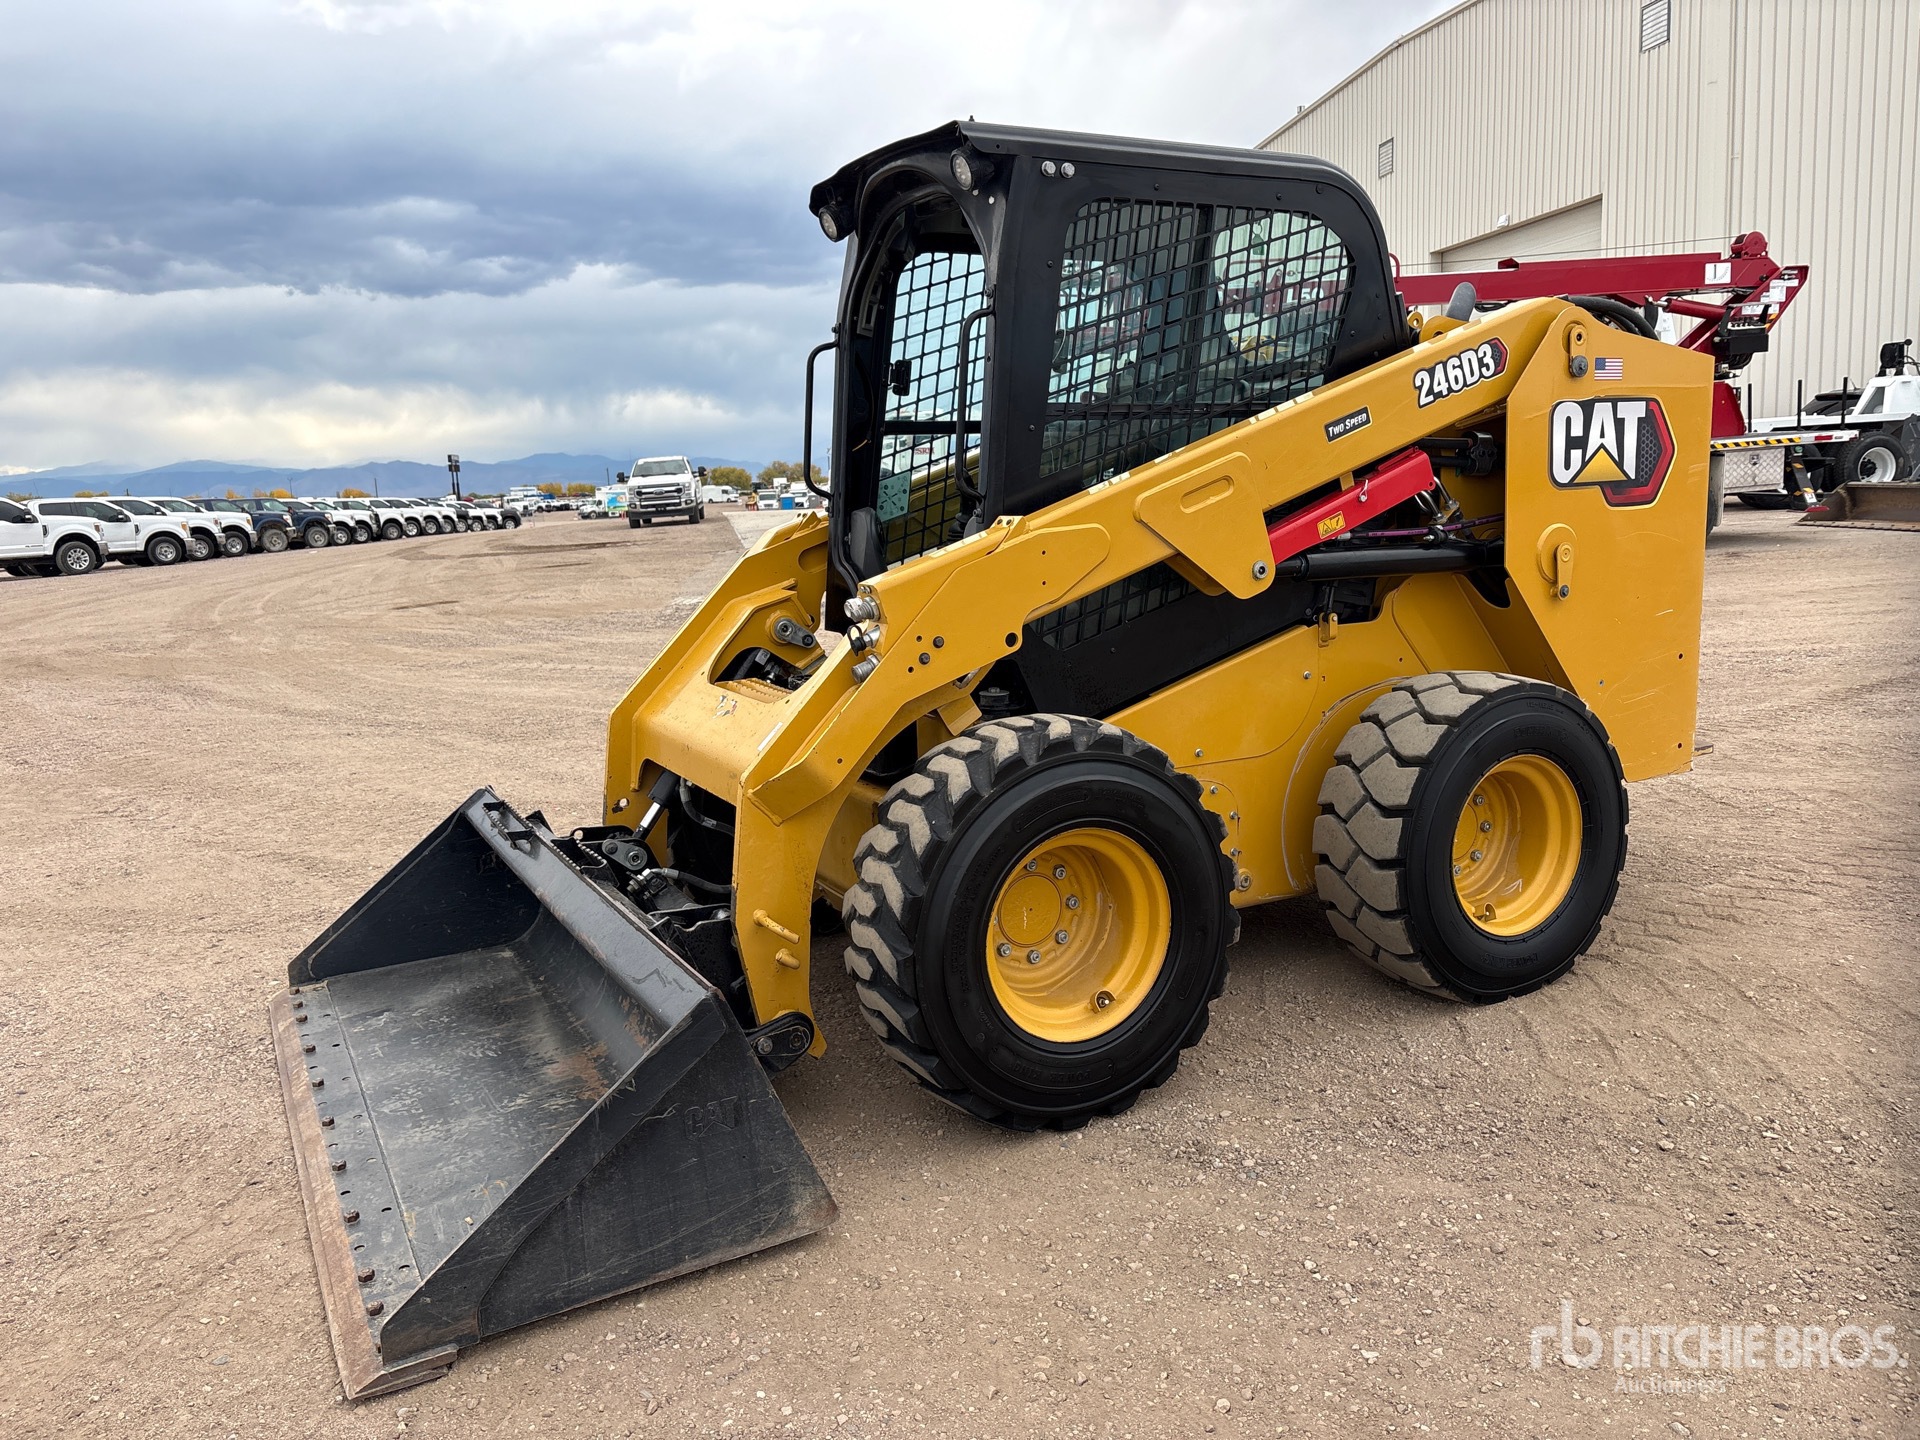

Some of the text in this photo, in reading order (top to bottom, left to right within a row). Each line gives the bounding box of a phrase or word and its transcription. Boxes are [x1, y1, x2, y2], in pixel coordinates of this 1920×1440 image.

[1414, 343, 1496, 407] 246D3
[1552, 400, 1647, 484] CAT
[683, 1095, 739, 1141] CAT
